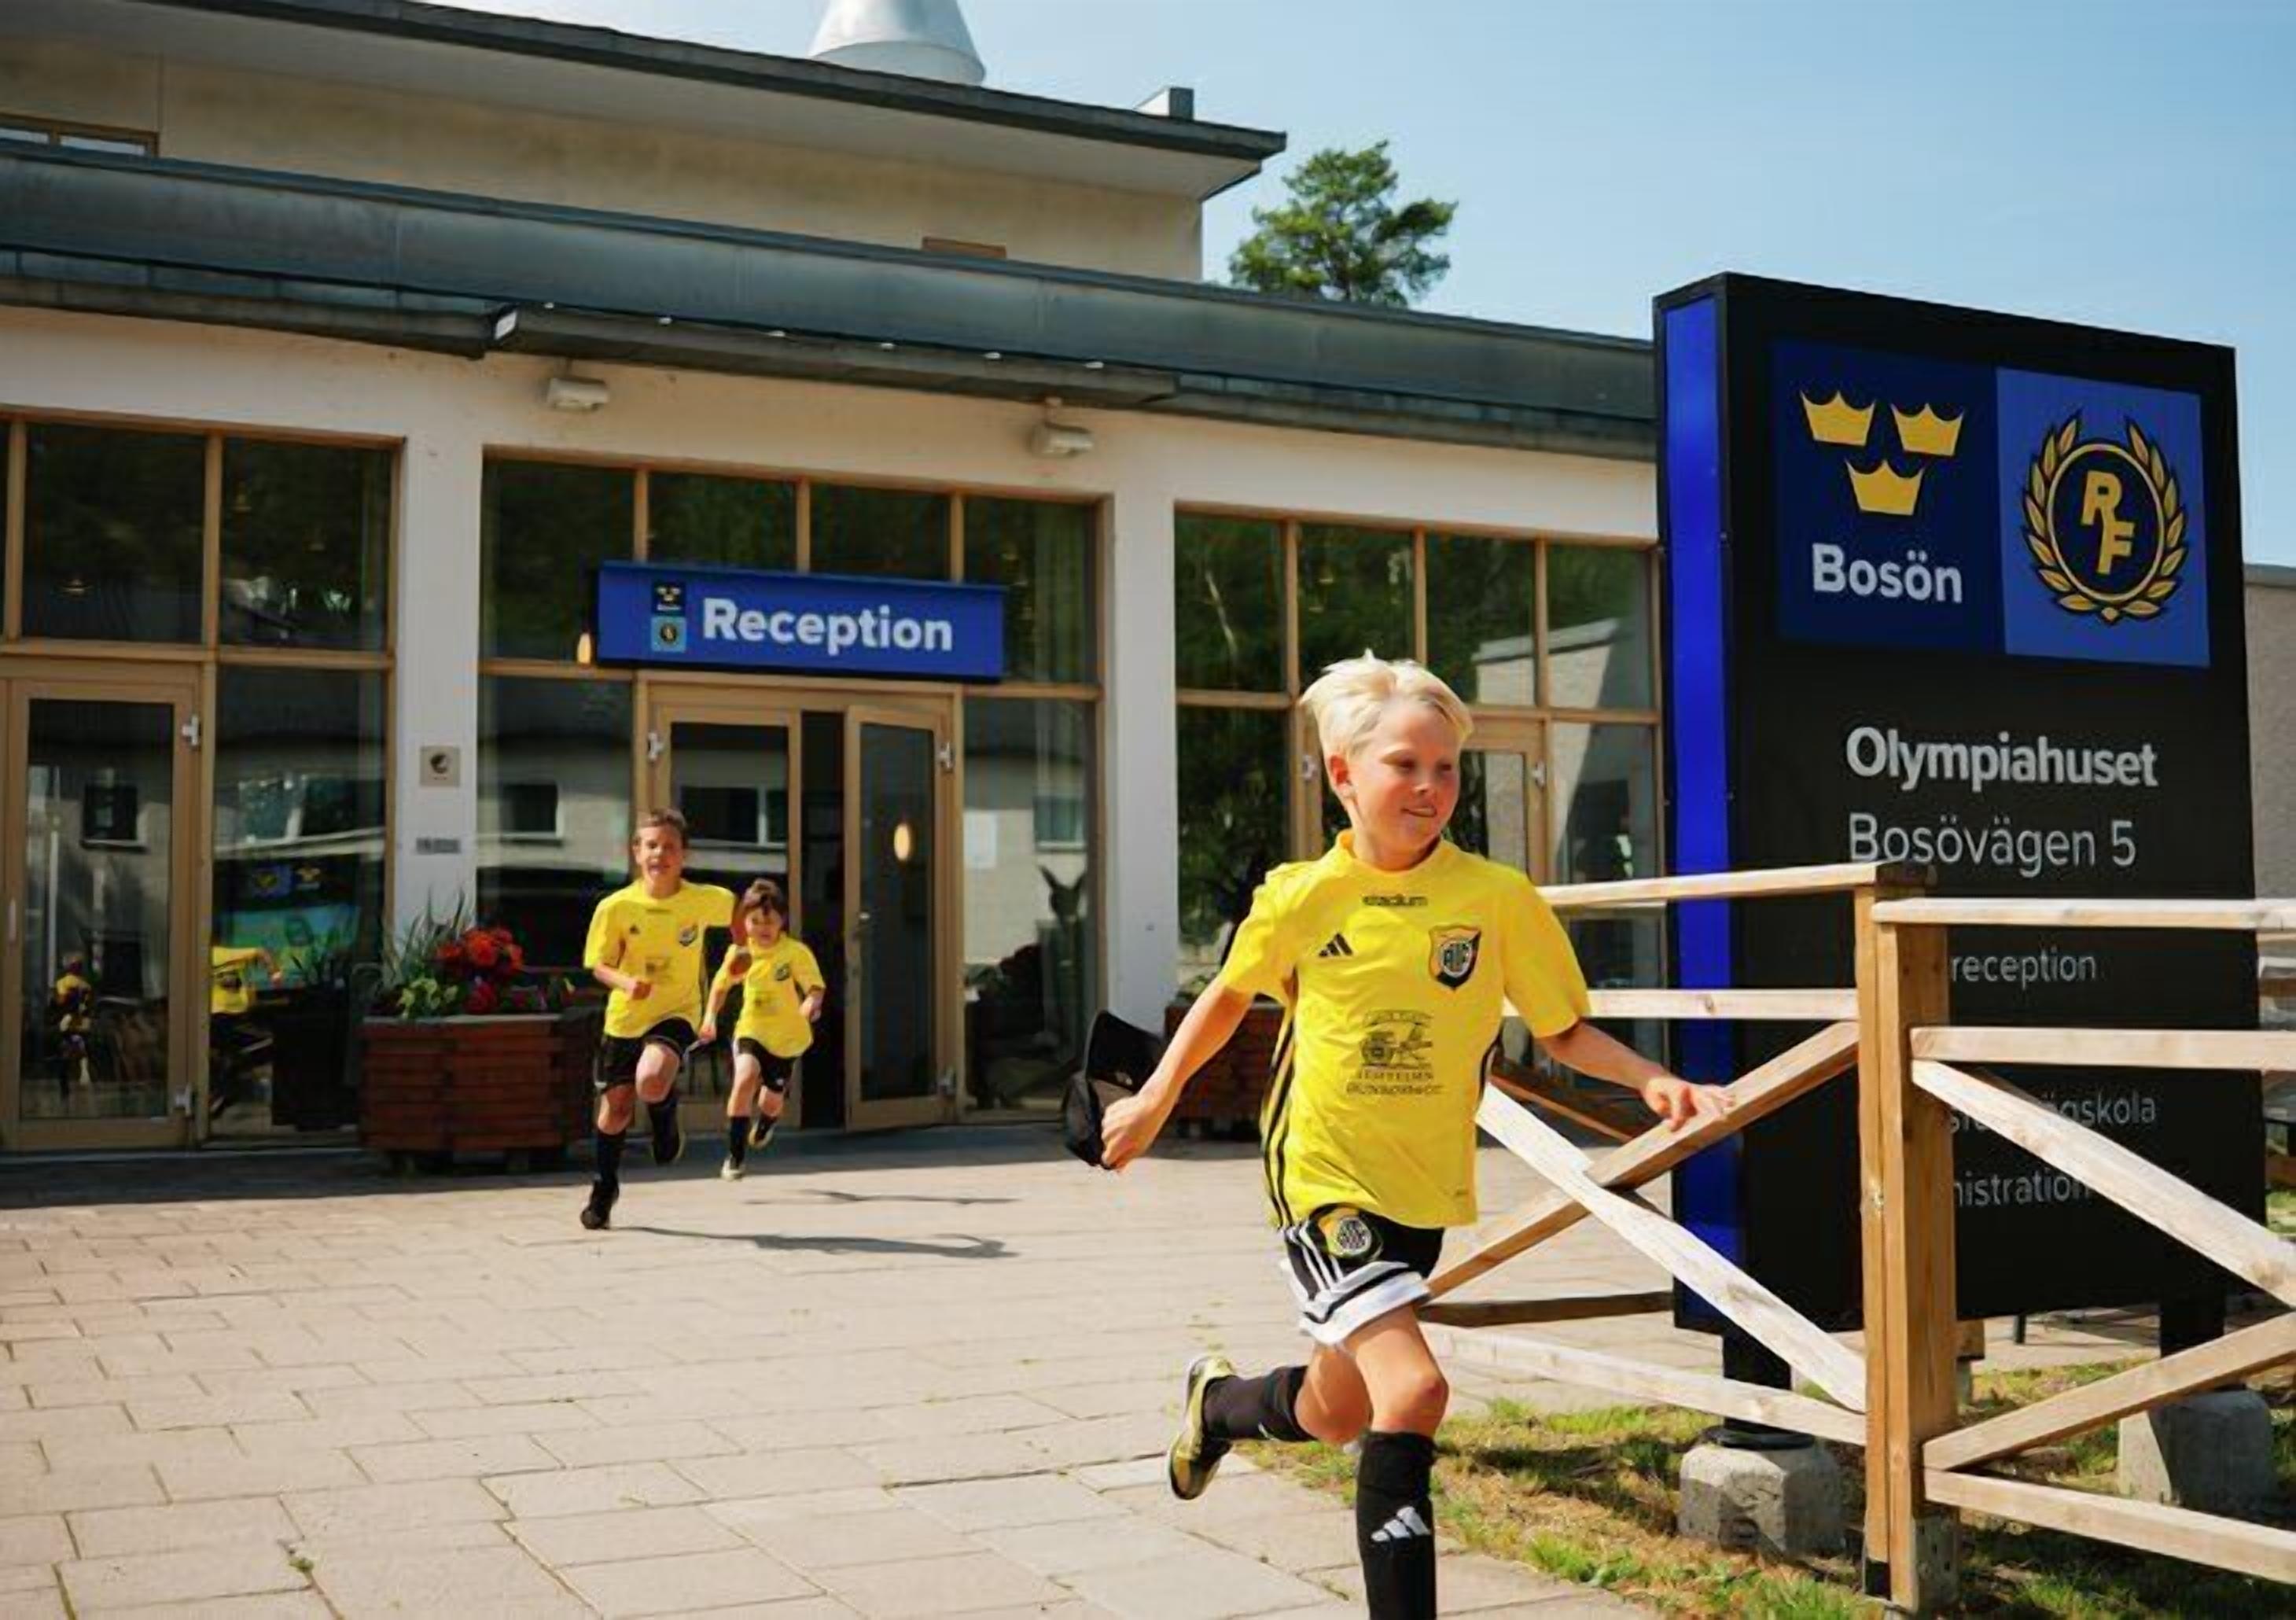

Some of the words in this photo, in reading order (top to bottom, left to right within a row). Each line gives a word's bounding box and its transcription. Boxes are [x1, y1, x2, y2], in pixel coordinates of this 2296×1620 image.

[1812, 543, 1963, 603] Bosön
[702, 597, 953, 656] Reception
[1845, 726, 2158, 793] Olympiahuset
[1849, 812, 2095, 878] Bosövägen
[2110, 819, 2137, 867] 5
[1952, 945, 2096, 991] reception
[1953, 1170, 2089, 1206] nistration
